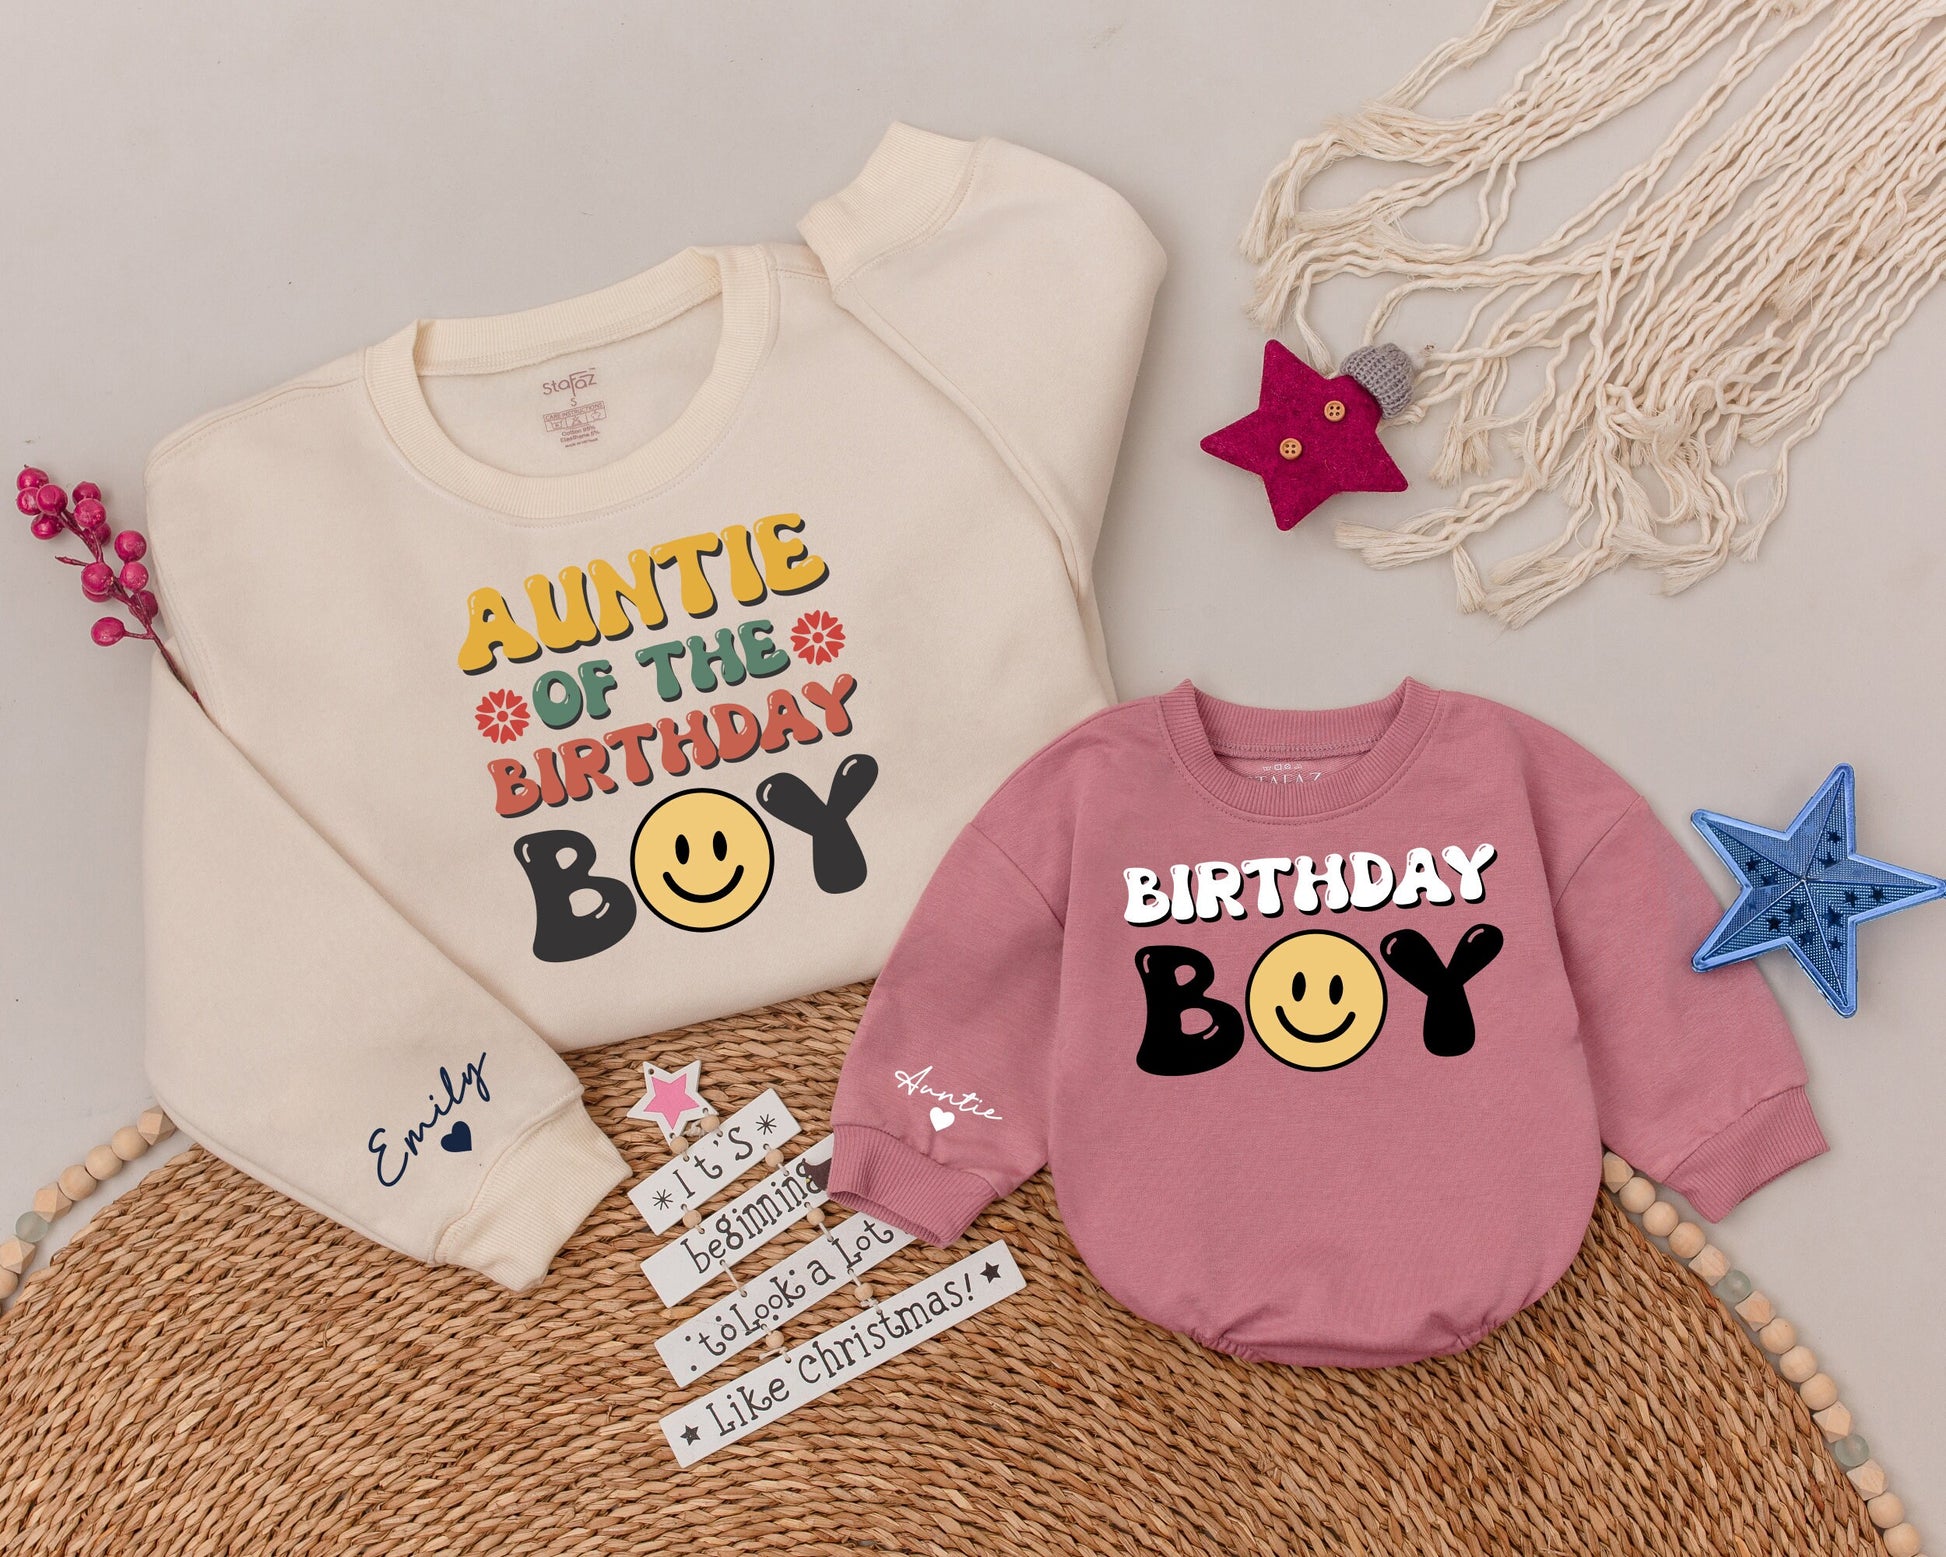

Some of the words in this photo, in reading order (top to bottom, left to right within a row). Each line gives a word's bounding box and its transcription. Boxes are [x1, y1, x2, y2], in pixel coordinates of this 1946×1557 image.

[457, 513, 830, 675] AUNTIE
[532, 659, 617, 730] OF
[635, 619, 791, 701] THE
[487, 673, 857, 818] BIRTHDAY
[1123, 843, 1497, 927] BIRTHDAY
[368, 1052, 490, 1187] Emily
[895, 1065, 1002, 1120] Auntie
[680, 1158, 823, 1274] beginning
[807, 1259, 836, 1286] a
[831, 1220, 894, 1269] Lot
[705, 1378, 790, 1437] Like
